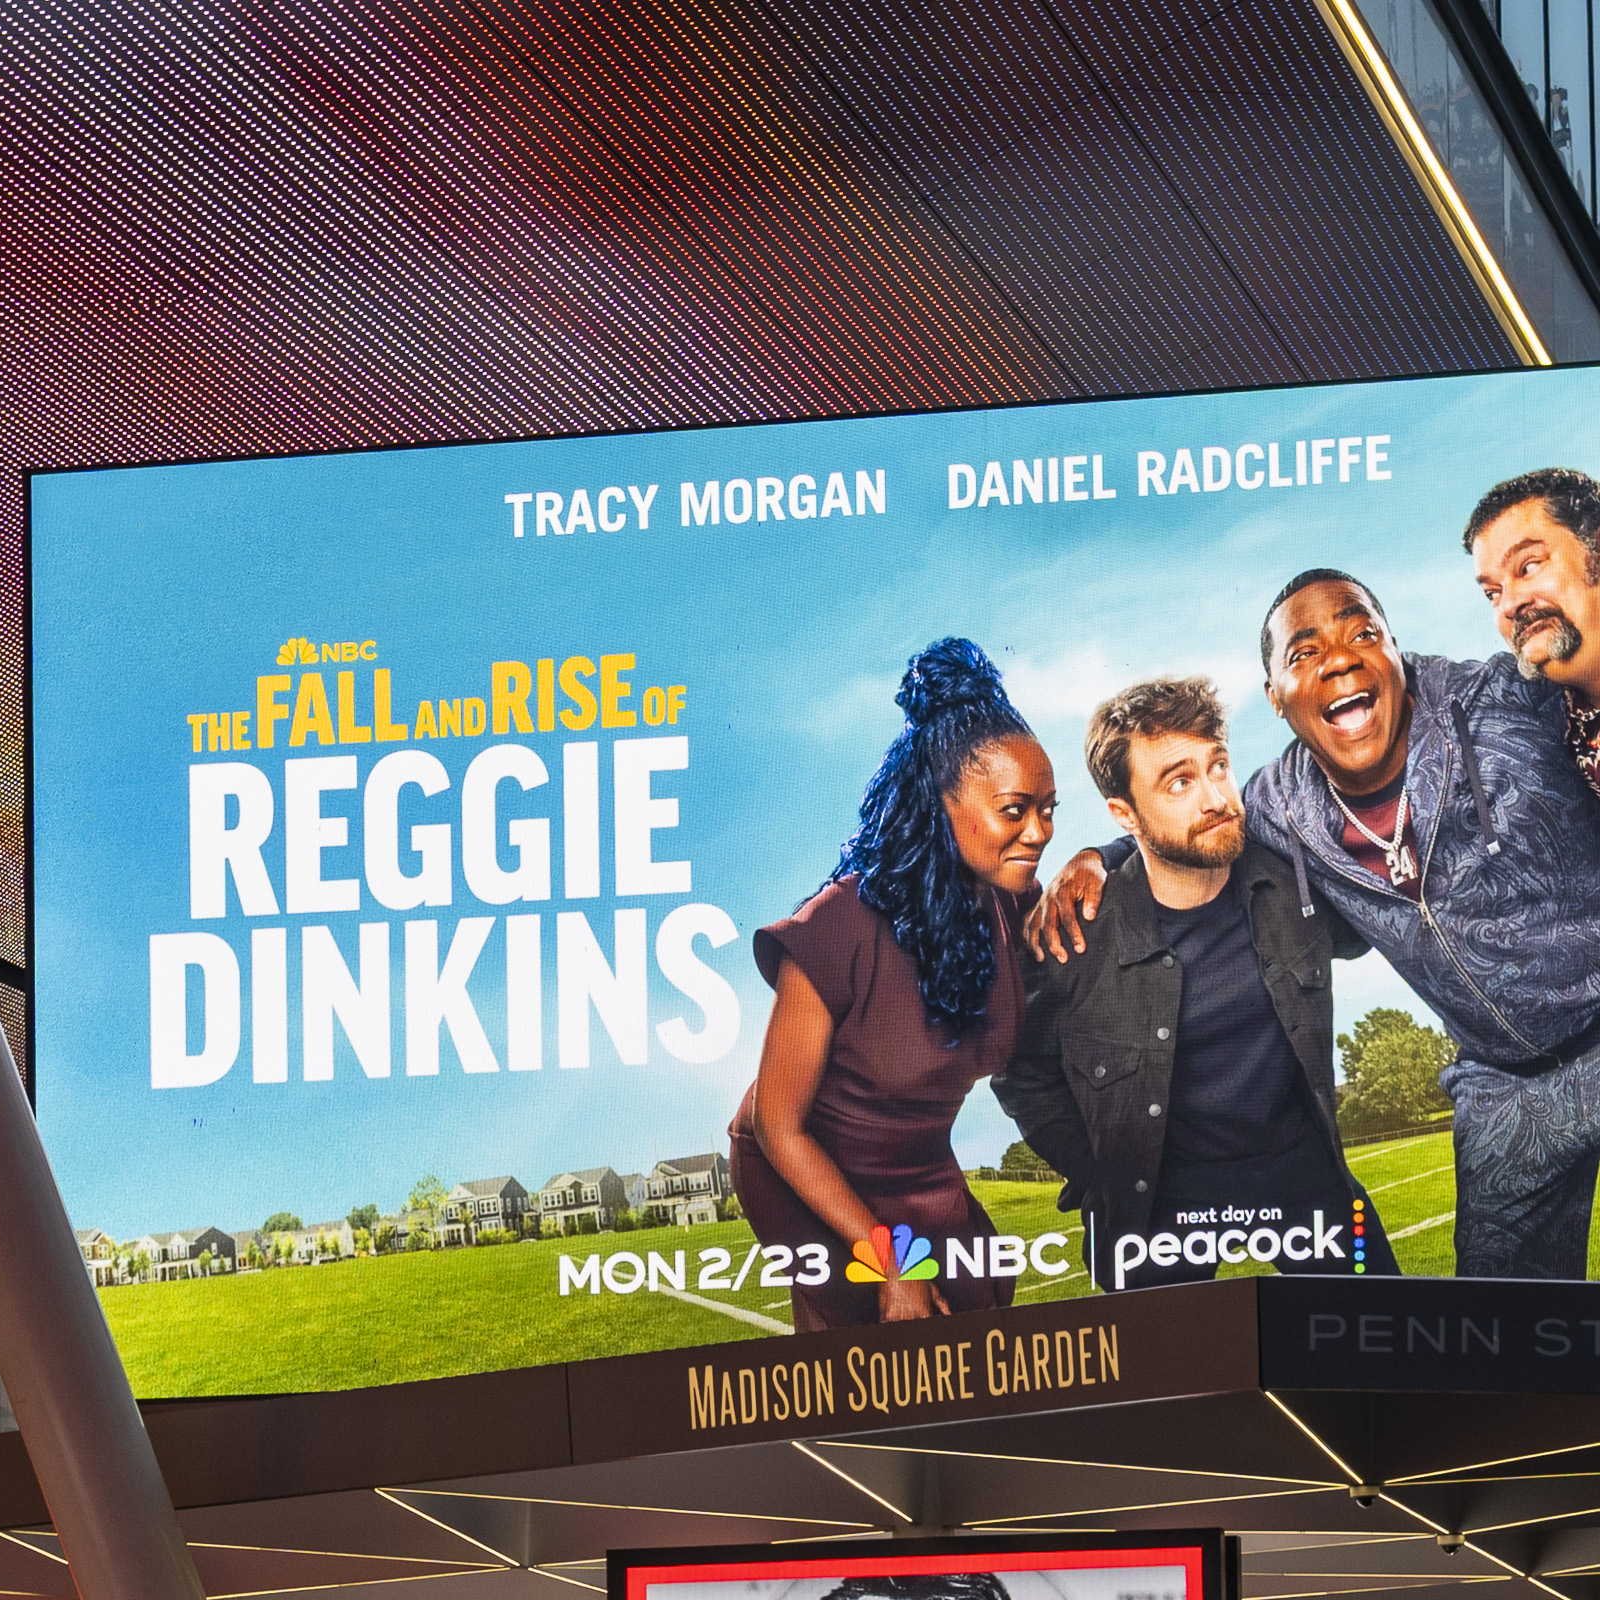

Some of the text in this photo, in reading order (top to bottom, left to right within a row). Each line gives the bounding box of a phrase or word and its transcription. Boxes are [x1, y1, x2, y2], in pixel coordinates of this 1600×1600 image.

[504, 469, 886, 538] TRACY MORGAN
[948, 434, 1393, 510] DANIEL RADCLIFFE
[321, 639, 378, 663] NBC
[187, 653, 687, 752] THE FALL AND RISE OF
[188, 735, 692, 919] REGGIE
[1386, 845, 1418, 886] 24
[149, 903, 741, 1090] DINKINS
[1114, 1209, 1346, 1290] peacock
[1177, 1205, 1283, 1227] next day on
[558, 1231, 1070, 1297] MON 2/23 NBC
[1308, 1313, 1500, 1355] PENN
[689, 1324, 1120, 1430] MADISON SQUARE GARDEN
